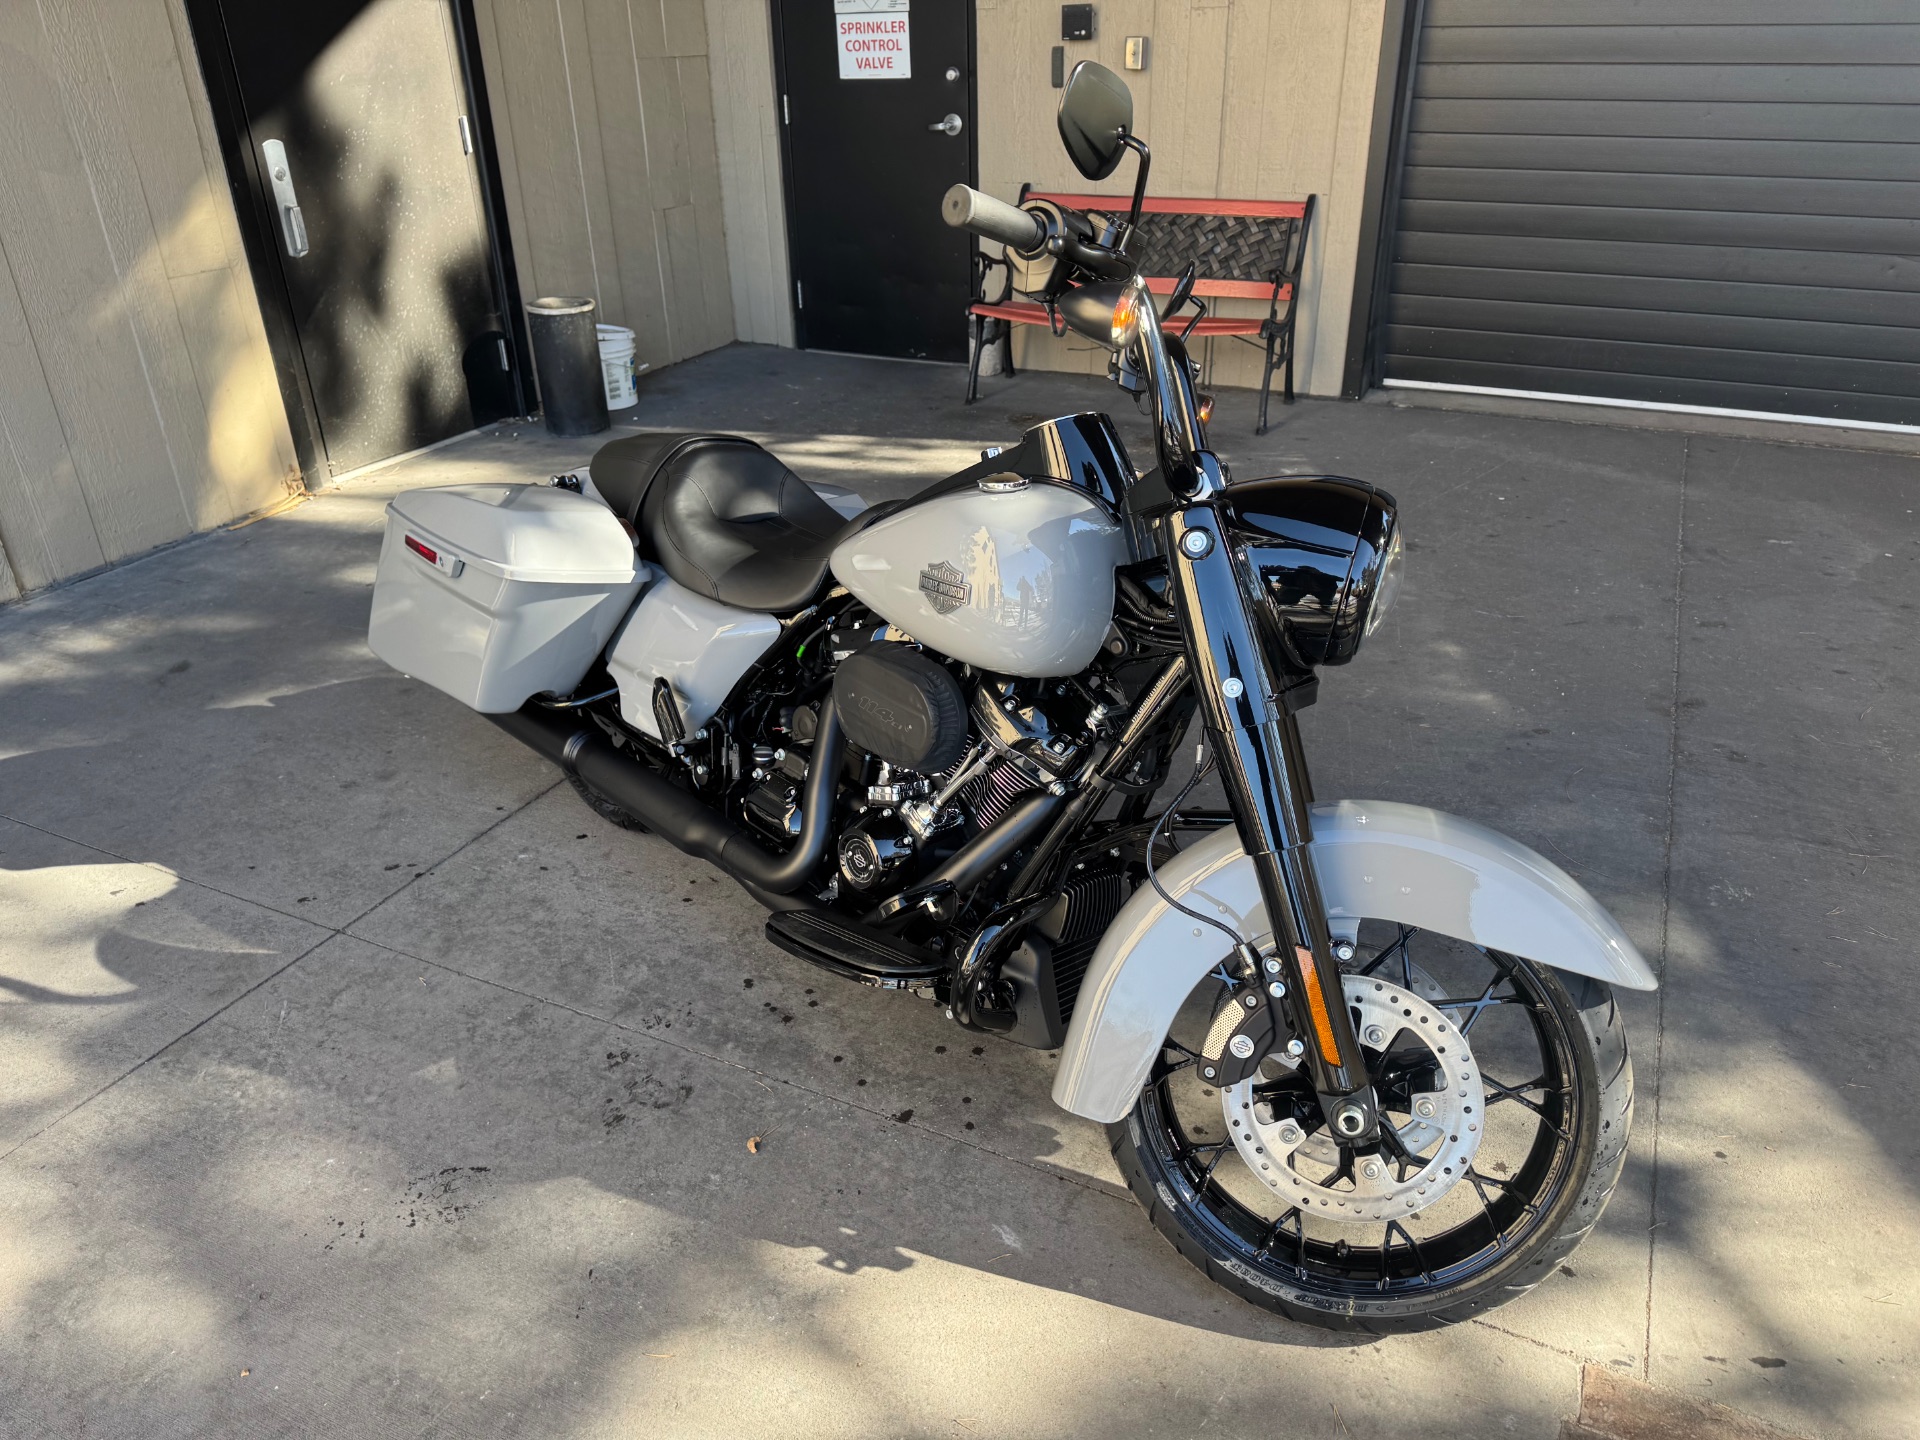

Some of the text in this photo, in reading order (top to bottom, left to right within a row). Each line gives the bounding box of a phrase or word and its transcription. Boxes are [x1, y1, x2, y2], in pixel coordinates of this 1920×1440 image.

[840, 21, 906, 34] SPRINKLER
[845, 39, 902, 52] CONTROL
[856, 57, 893, 69] VALVE
[858, 696, 894, 722] 114
